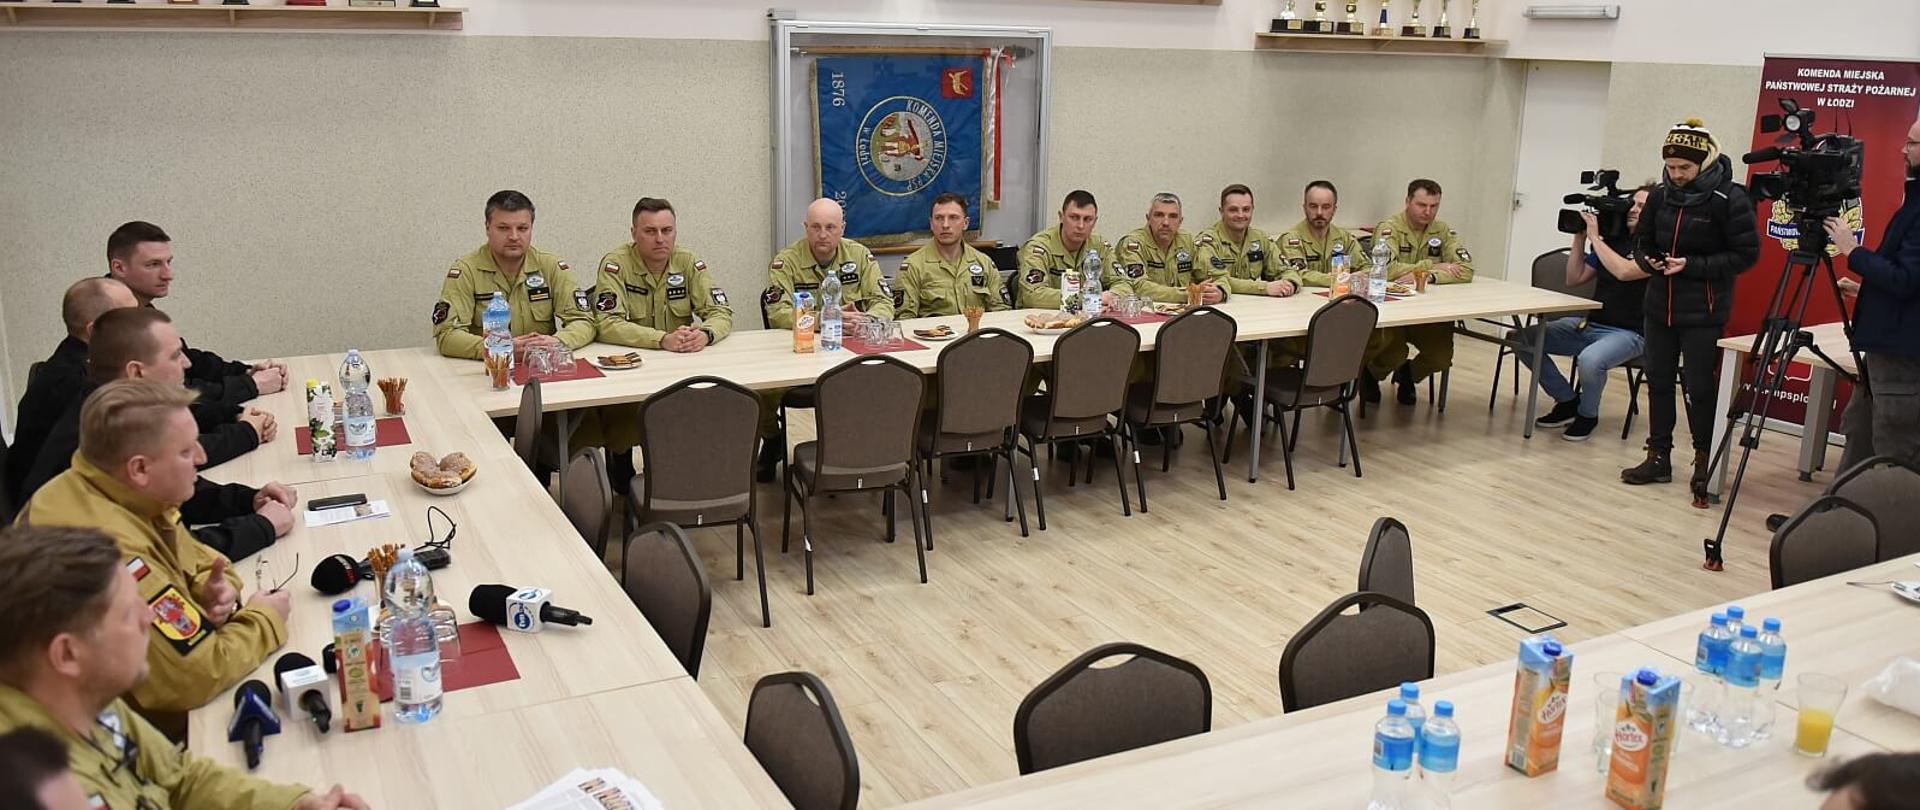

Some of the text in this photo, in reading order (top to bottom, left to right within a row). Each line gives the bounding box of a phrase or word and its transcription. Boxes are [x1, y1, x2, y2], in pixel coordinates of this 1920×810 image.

[1797, 68, 1885, 81] KOMENDA MIEJSKA
[831, 71, 846, 107] 1876
[1765, 79, 1917, 97] PAŃSTWOWEJ STRAŻY POŻARNEJ
[1817, 97, 1855, 108] W ŁODZI
[906, 99, 942, 137] KOMENDA
